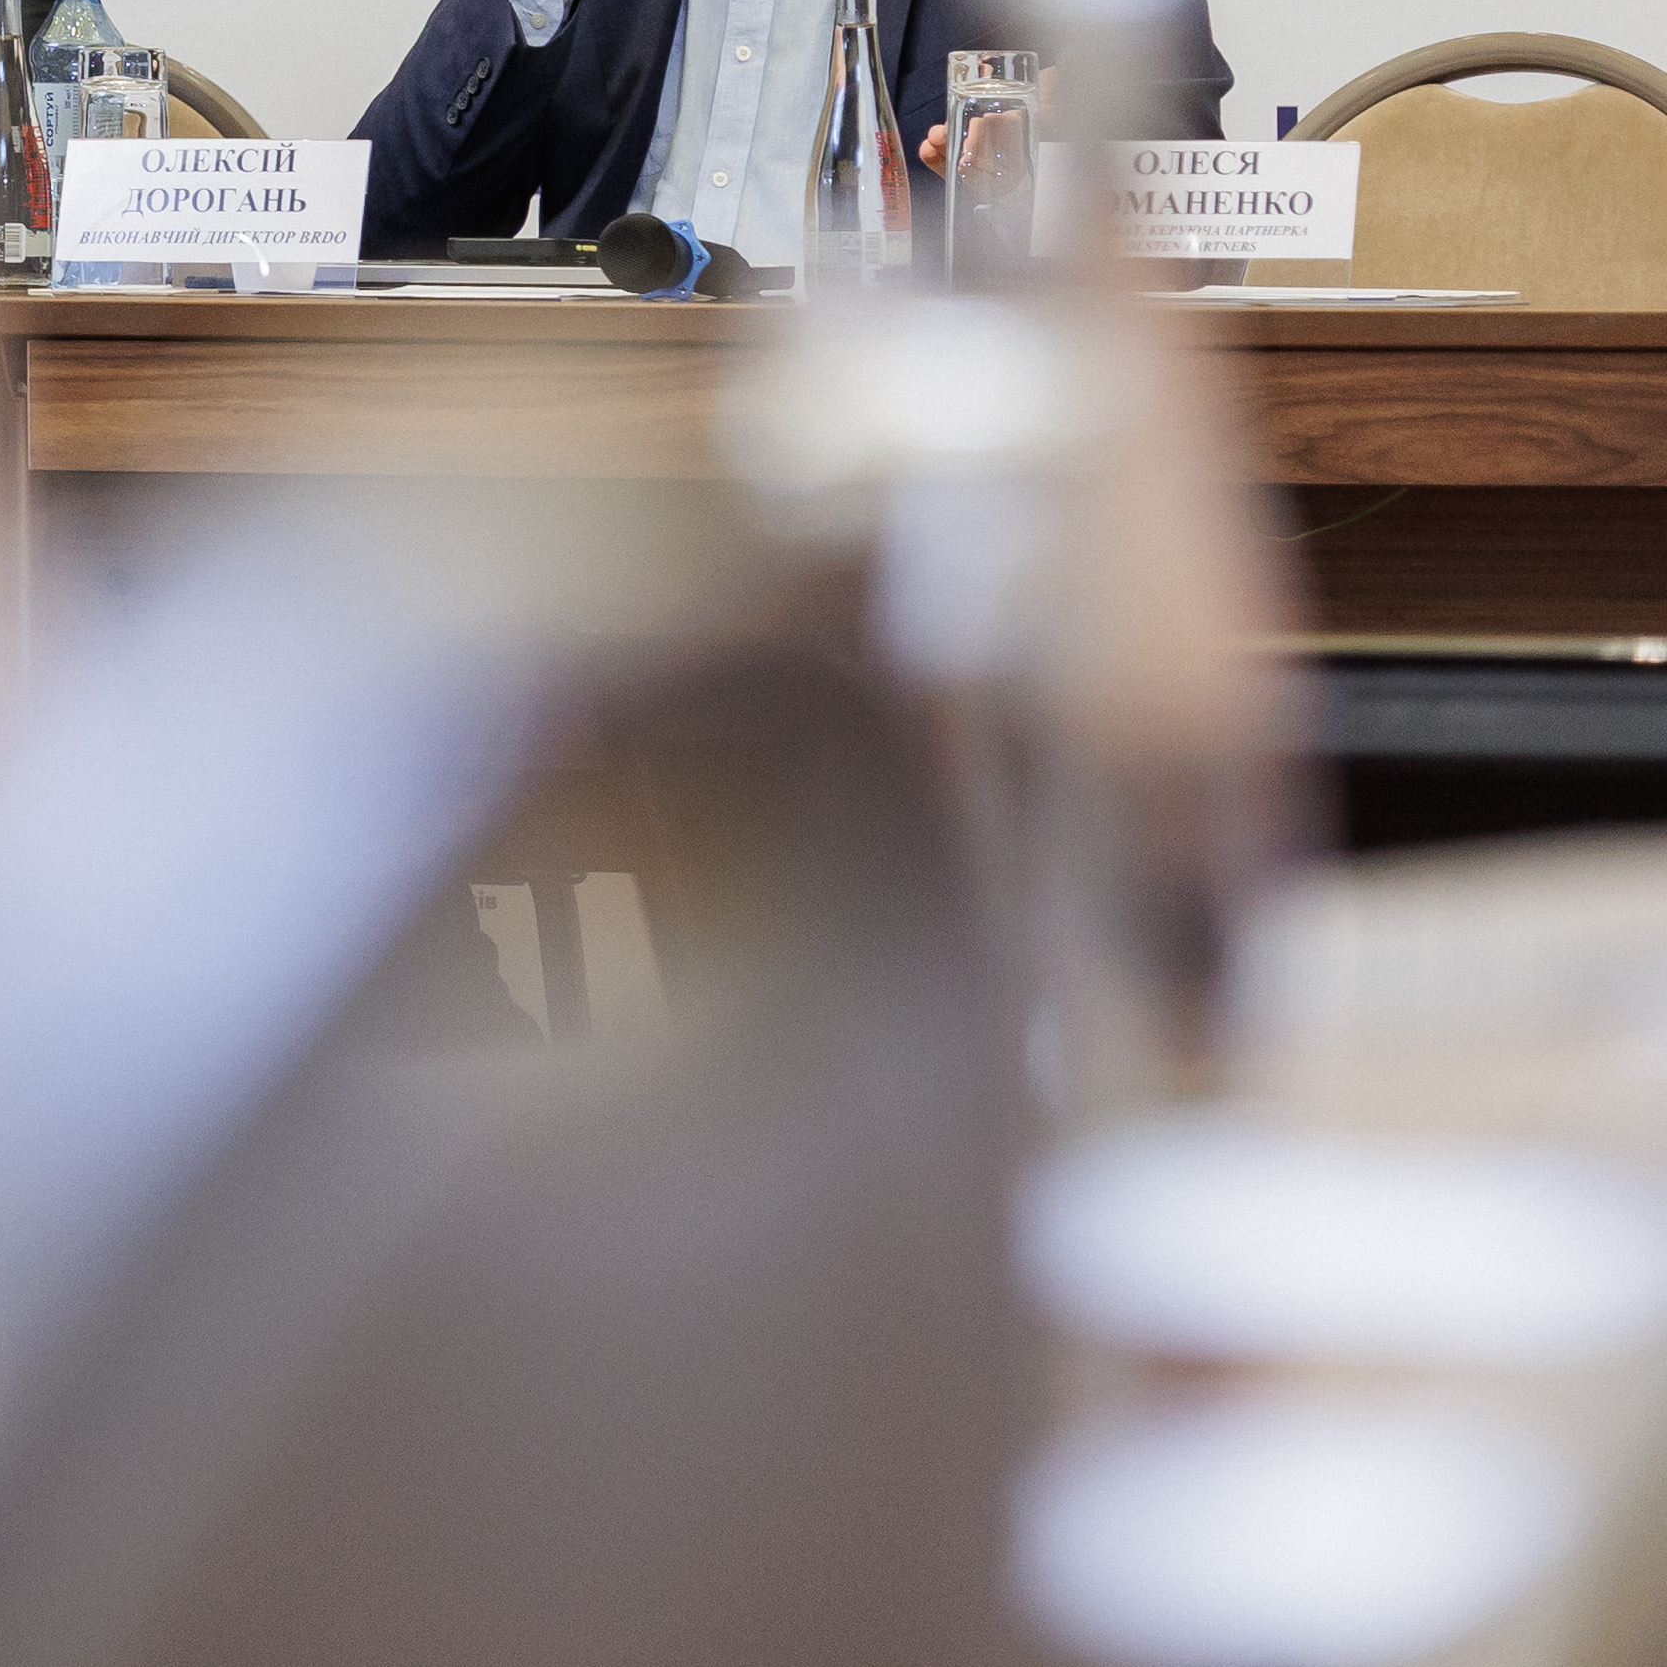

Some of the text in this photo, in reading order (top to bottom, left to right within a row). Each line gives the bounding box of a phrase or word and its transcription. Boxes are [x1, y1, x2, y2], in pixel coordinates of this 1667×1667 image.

[44, 91, 55, 147] СОРТУЙ
[141, 143, 296, 173] ОЛЕКСІЙ
[1133, 150, 1263, 176] ОЛЕСЯ
[122, 188, 308, 216] ДОРОГАНЬ
[1113, 190, 1314, 216] МАНЕНКО
[79, 227, 201, 245] ВИКОНАВЧИЙ
[299, 230, 348, 244] BRDO
[1225, 225, 1310, 237] ПАРТНЕРКА
